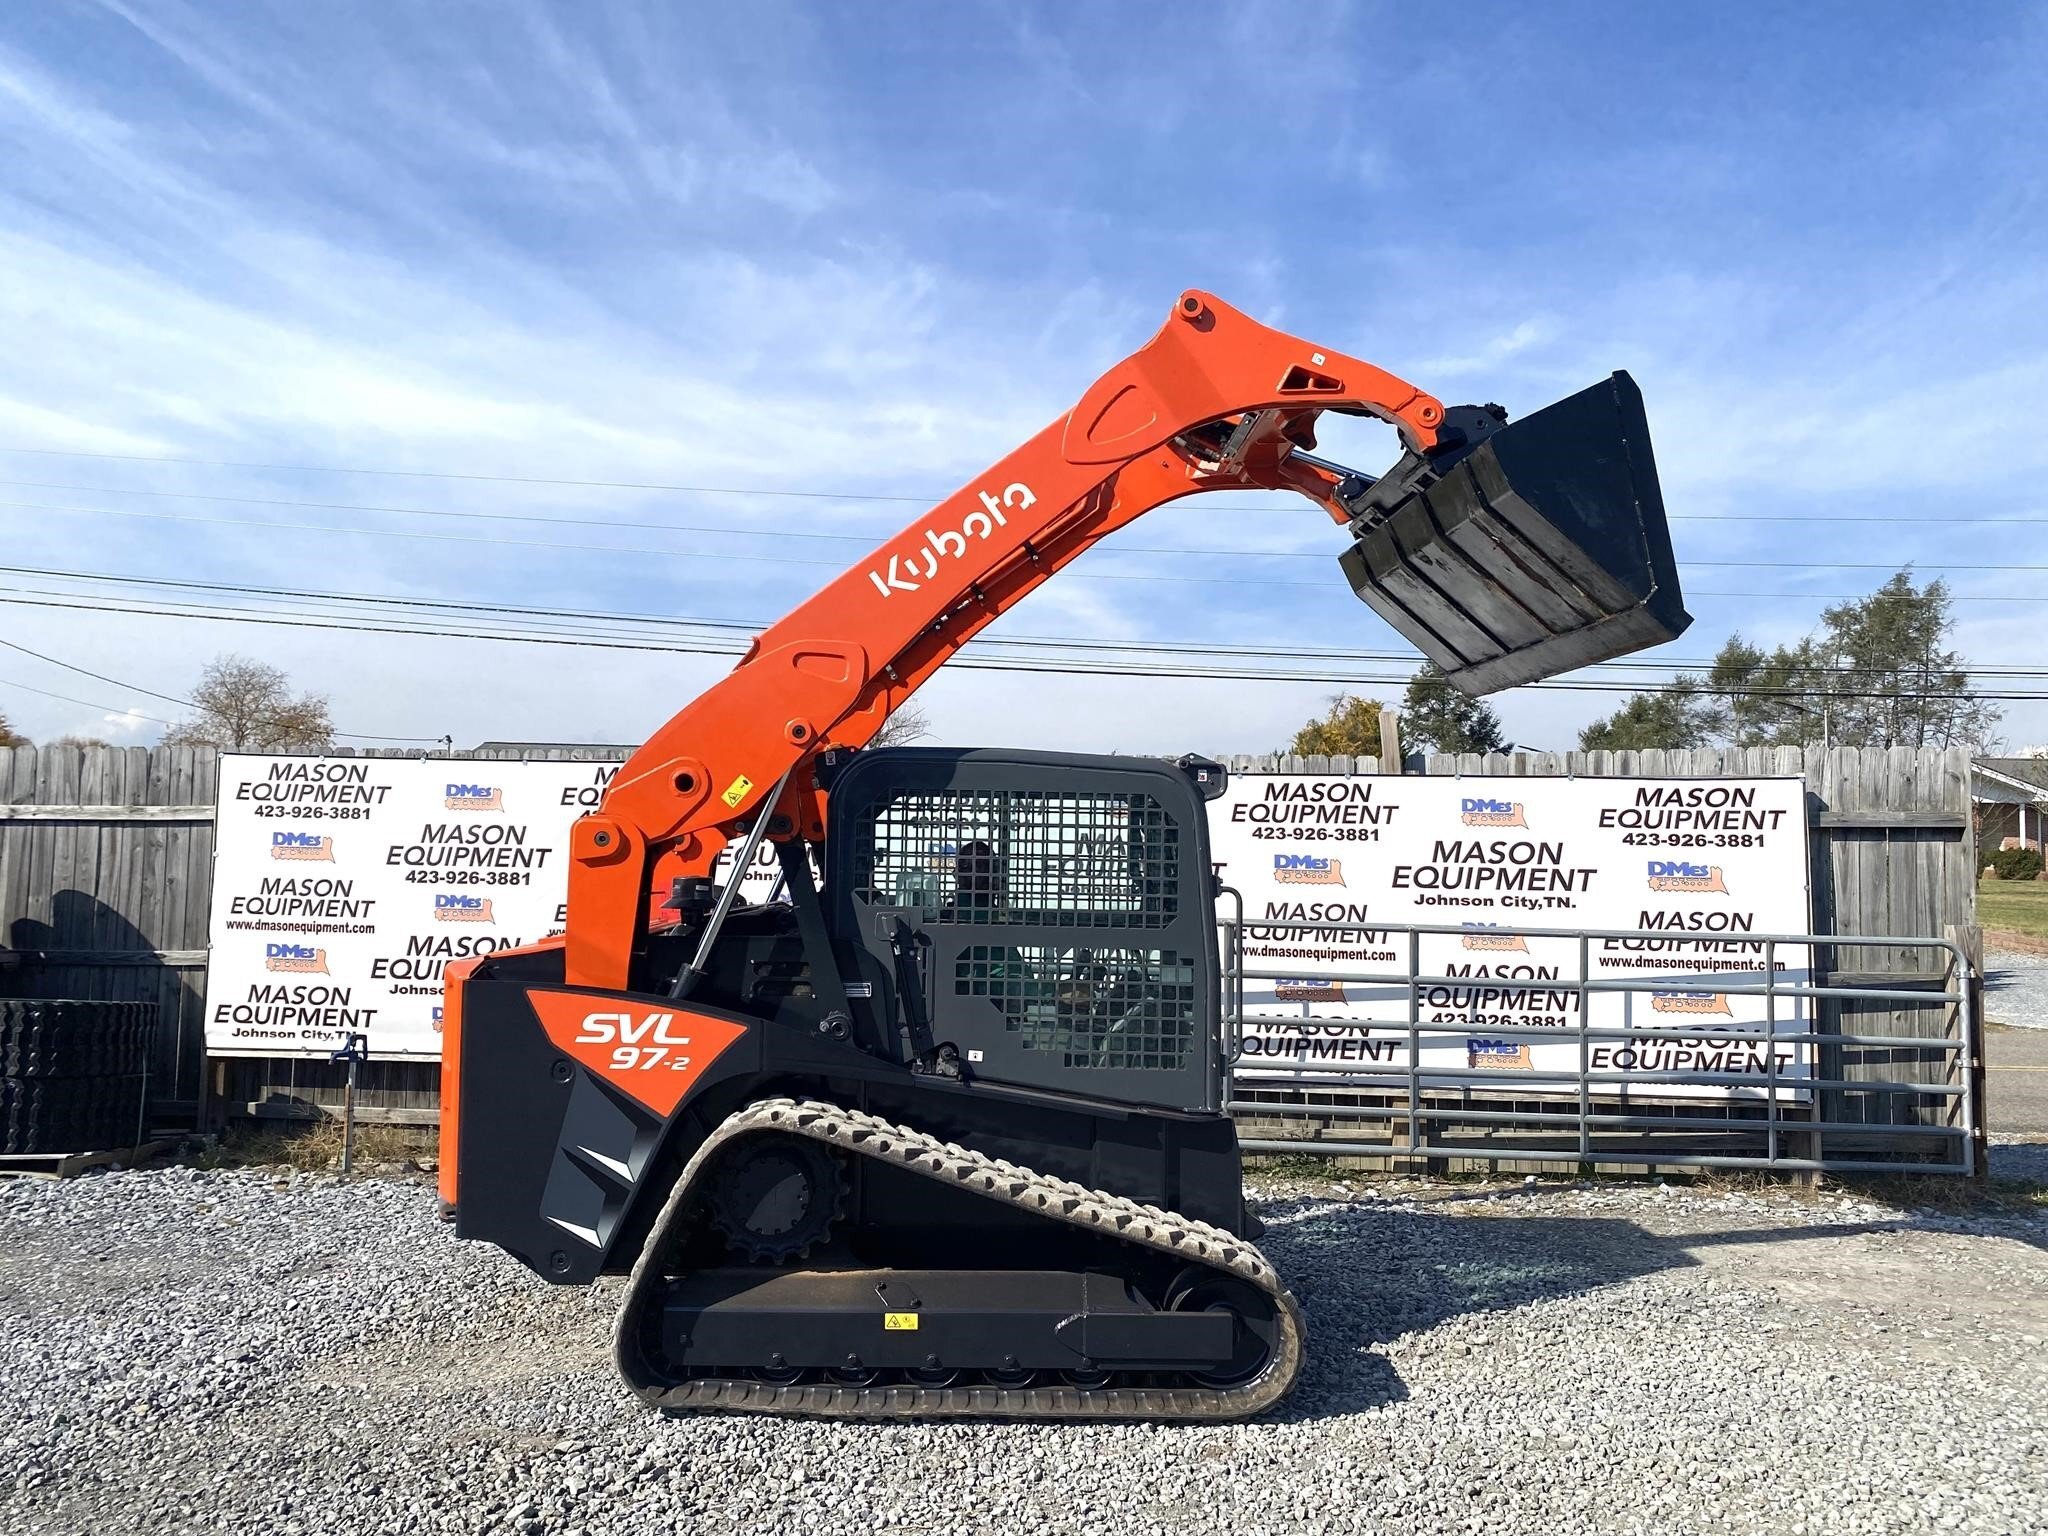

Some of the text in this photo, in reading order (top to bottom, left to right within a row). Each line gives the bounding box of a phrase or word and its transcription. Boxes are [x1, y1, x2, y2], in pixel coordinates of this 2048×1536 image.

[868, 482, 1038, 598] Kubota
[267, 763, 368, 784] MASON
[236, 783, 391, 804] EQUIPMENT
[1265, 783, 1372, 802] MASON
[1636, 788, 1755, 808] MASON
[255, 805, 371, 820] 423-926-3881
[1232, 804, 1399, 825] EQUIPMENT
[1599, 809, 1786, 830] EQUIPMENT
[419, 824, 526, 846] MASON
[1252, 827, 1379, 841] 423-926-3881
[1622, 833, 1764, 847] 423-926-3881
[386, 846, 551, 868] EQUIPMENT
[1432, 841, 1563, 865] MASON
[260, 878, 353, 897] MASON
[405, 870, 531, 885] 423-926-3881
[1392, 866, 1597, 892] EQUIPMENT
[231, 897, 375, 919] EQUIPMENT
[1265, 902, 1367, 922] MASON
[1414, 894, 1577, 910] Johnson City,TN.
[226, 919, 375, 935] www.dmasonequipment.com
[1638, 911, 1753, 932] MASON
[1448, 964, 1559, 981] MASON
[1599, 955, 1786, 973] www.dmasonequipment.cm
[247, 985, 351, 1006] MASON
[214, 1005, 377, 1028] EQUIPMENT
[232, 1028, 296, 1040] Johnson
[575, 1013, 691, 1045] SVL
[608, 1046, 691, 1071] 97-2
[1240, 1035, 1402, 1062] QUIPMENT
